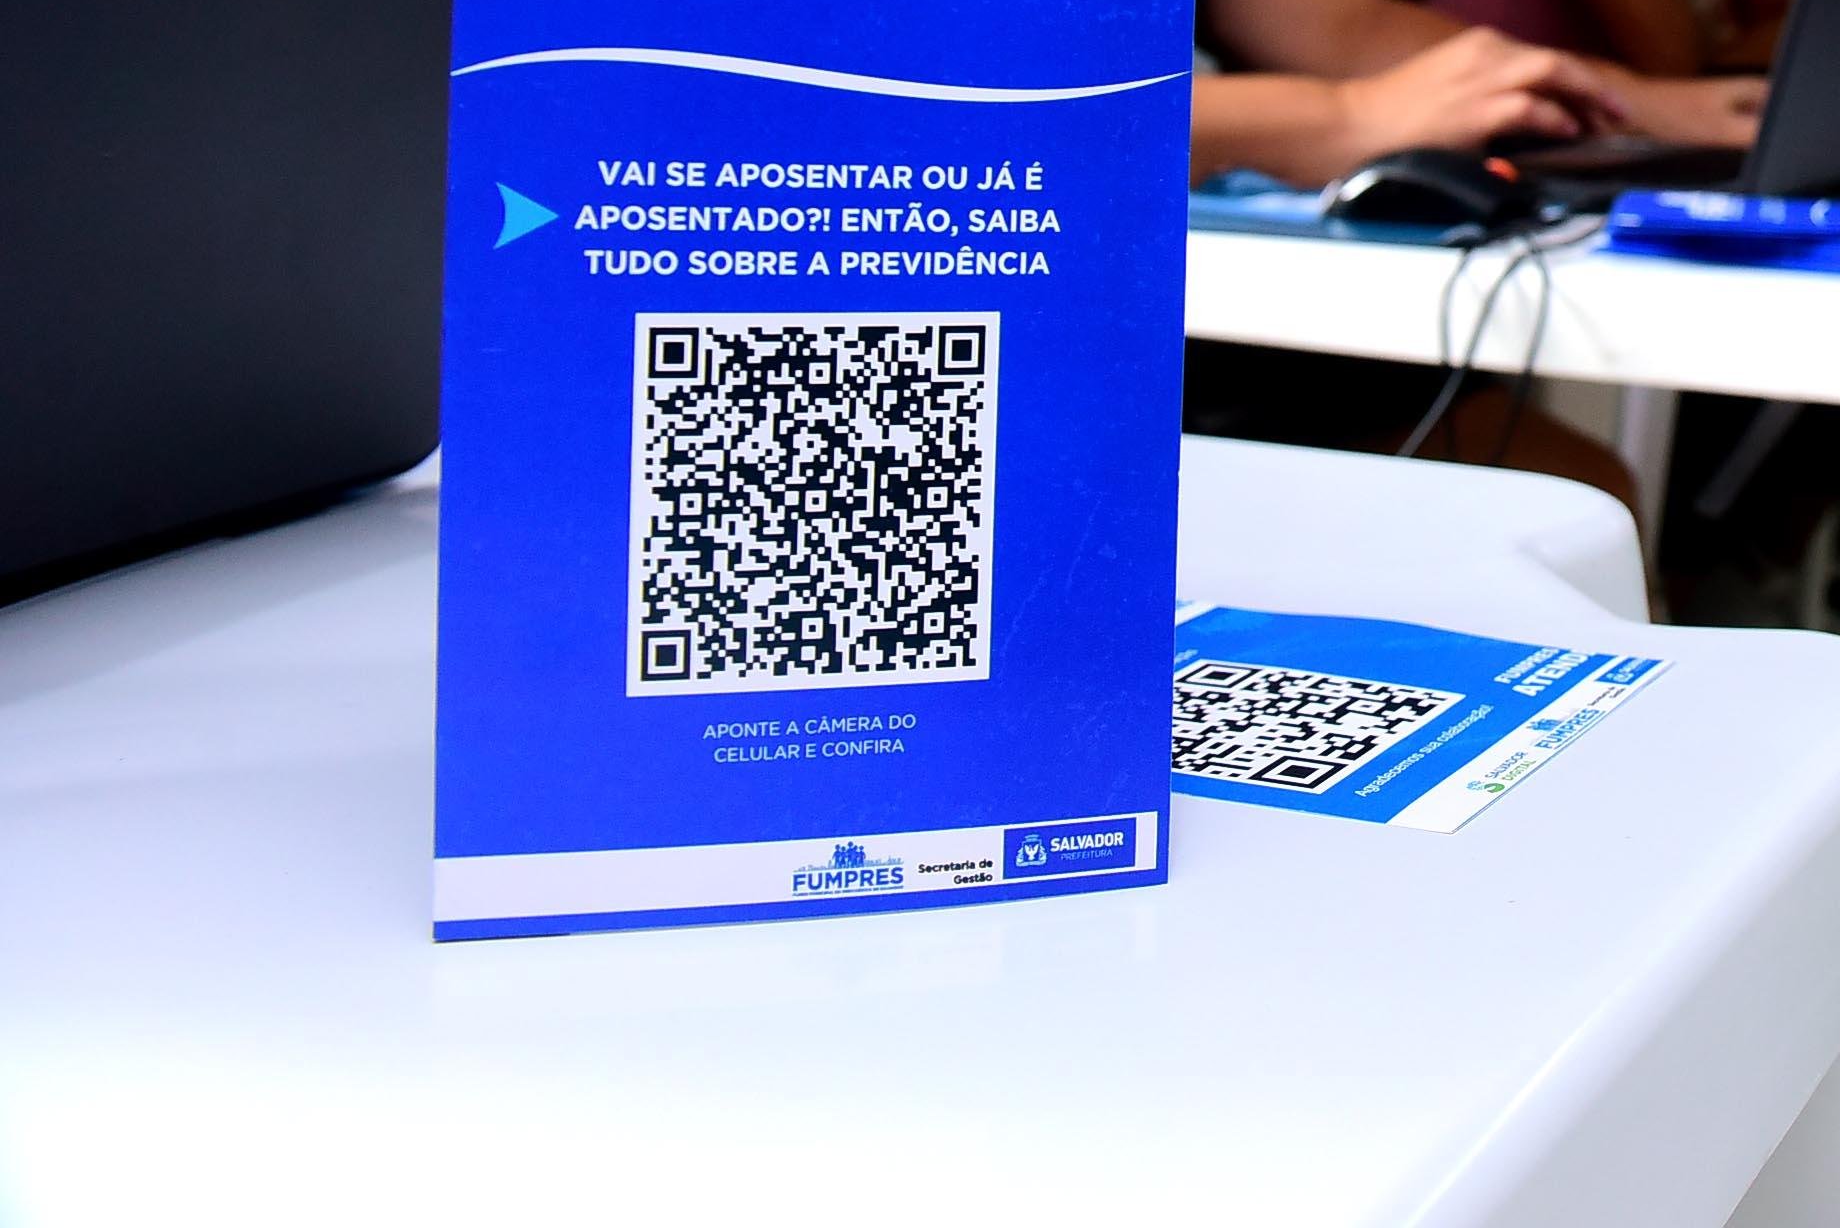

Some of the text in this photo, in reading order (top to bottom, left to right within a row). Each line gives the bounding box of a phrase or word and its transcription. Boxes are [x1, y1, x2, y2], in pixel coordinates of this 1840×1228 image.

[598, 161, 1043, 190] VAI SE APOSENTAR OU JÁ É
[575, 203, 1060, 236] APOSENTADO?! ENTÃO, SAIBA
[584, 246, 1049, 275] TUDO SOBRE A PREVIDÊNCIA
[1512, 651, 1595, 697] ATEND
[703, 714, 916, 739] APONTE A CÂMERA DO
[1535, 708, 1601, 749] FUMPRES
[714, 739, 904, 763] CELULAR E CONFIRA
[1354, 752, 1425, 797] Agradecemos
[1419, 740, 1441, 755] sua
[1485, 751, 1528, 779] SALVADOR
[1050, 832, 1124, 852] SALVADOR
[1061, 849, 1113, 861] PREFEITURA
[918, 858, 993, 873] Secretaria de
[953, 872, 993, 885] Gestão
[792, 867, 904, 891] FUMPRES
